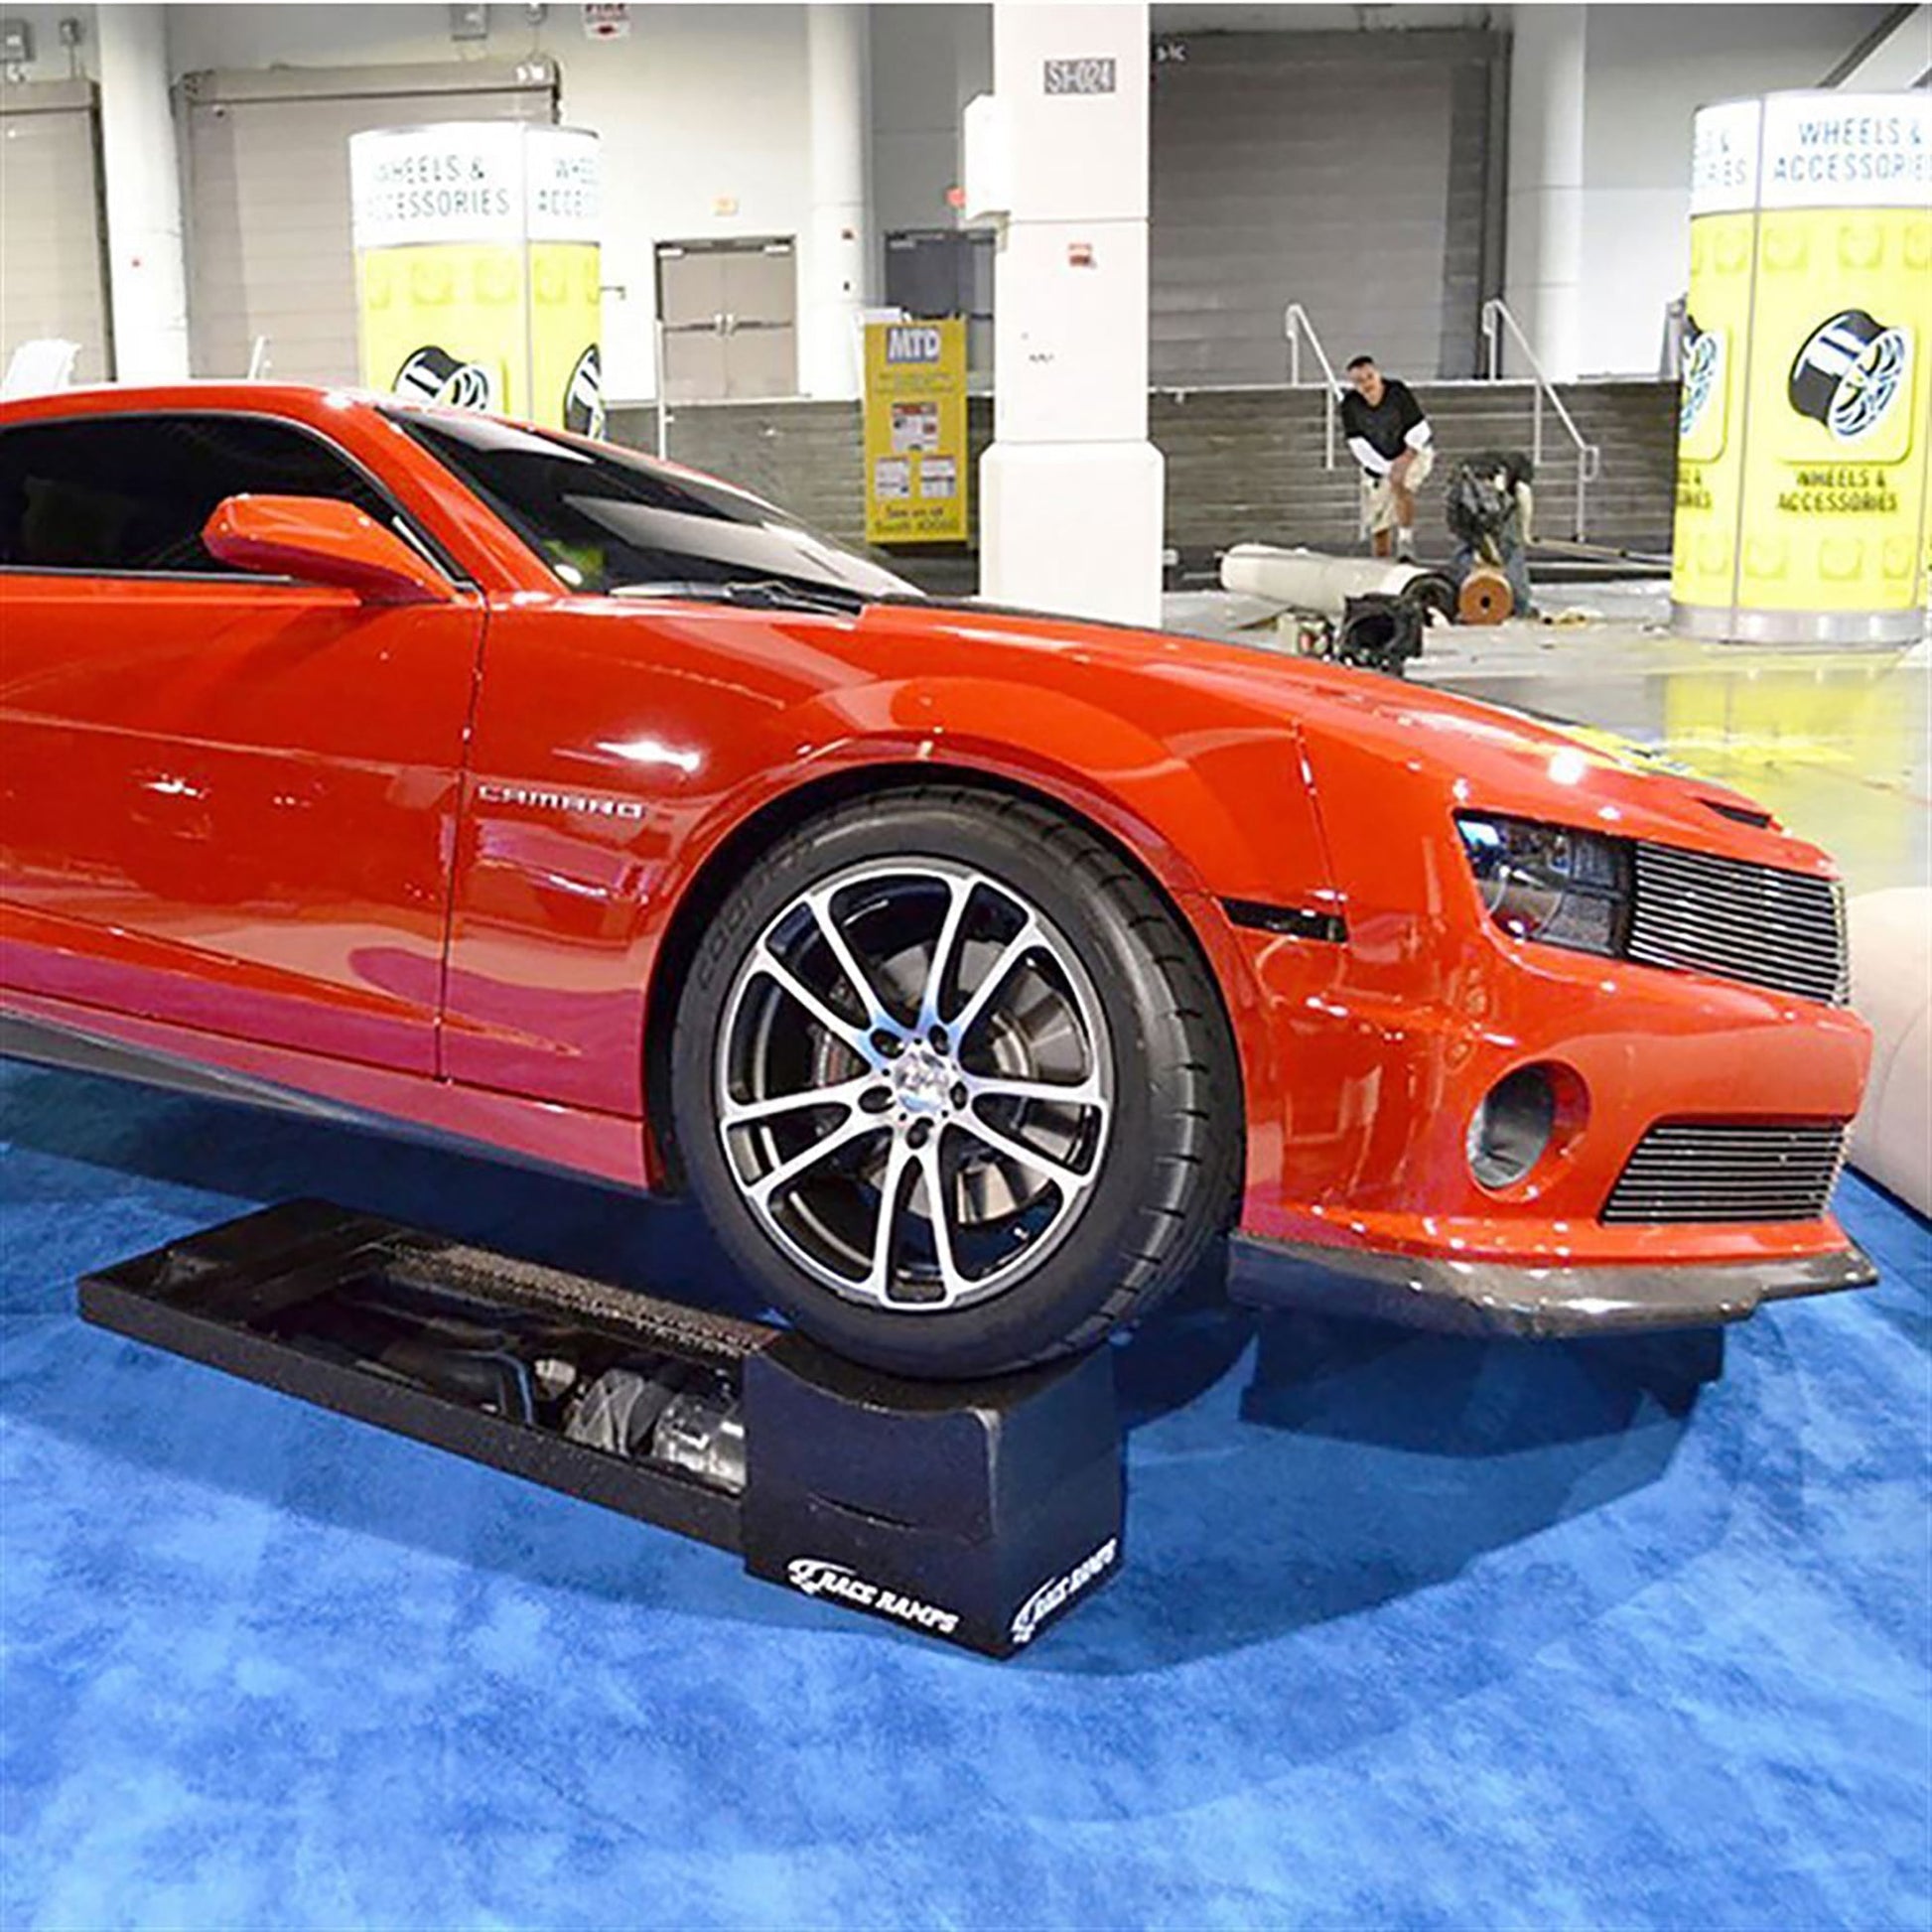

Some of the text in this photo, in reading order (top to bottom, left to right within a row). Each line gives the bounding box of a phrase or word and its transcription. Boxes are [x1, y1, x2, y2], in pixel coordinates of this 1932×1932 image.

[1798, 118, 1900, 145] WHEELS
[368, 189, 511, 219] CESSORIES
[479, 784, 645, 820] CAMARO
[875, 1590, 960, 1634] RAMPS
